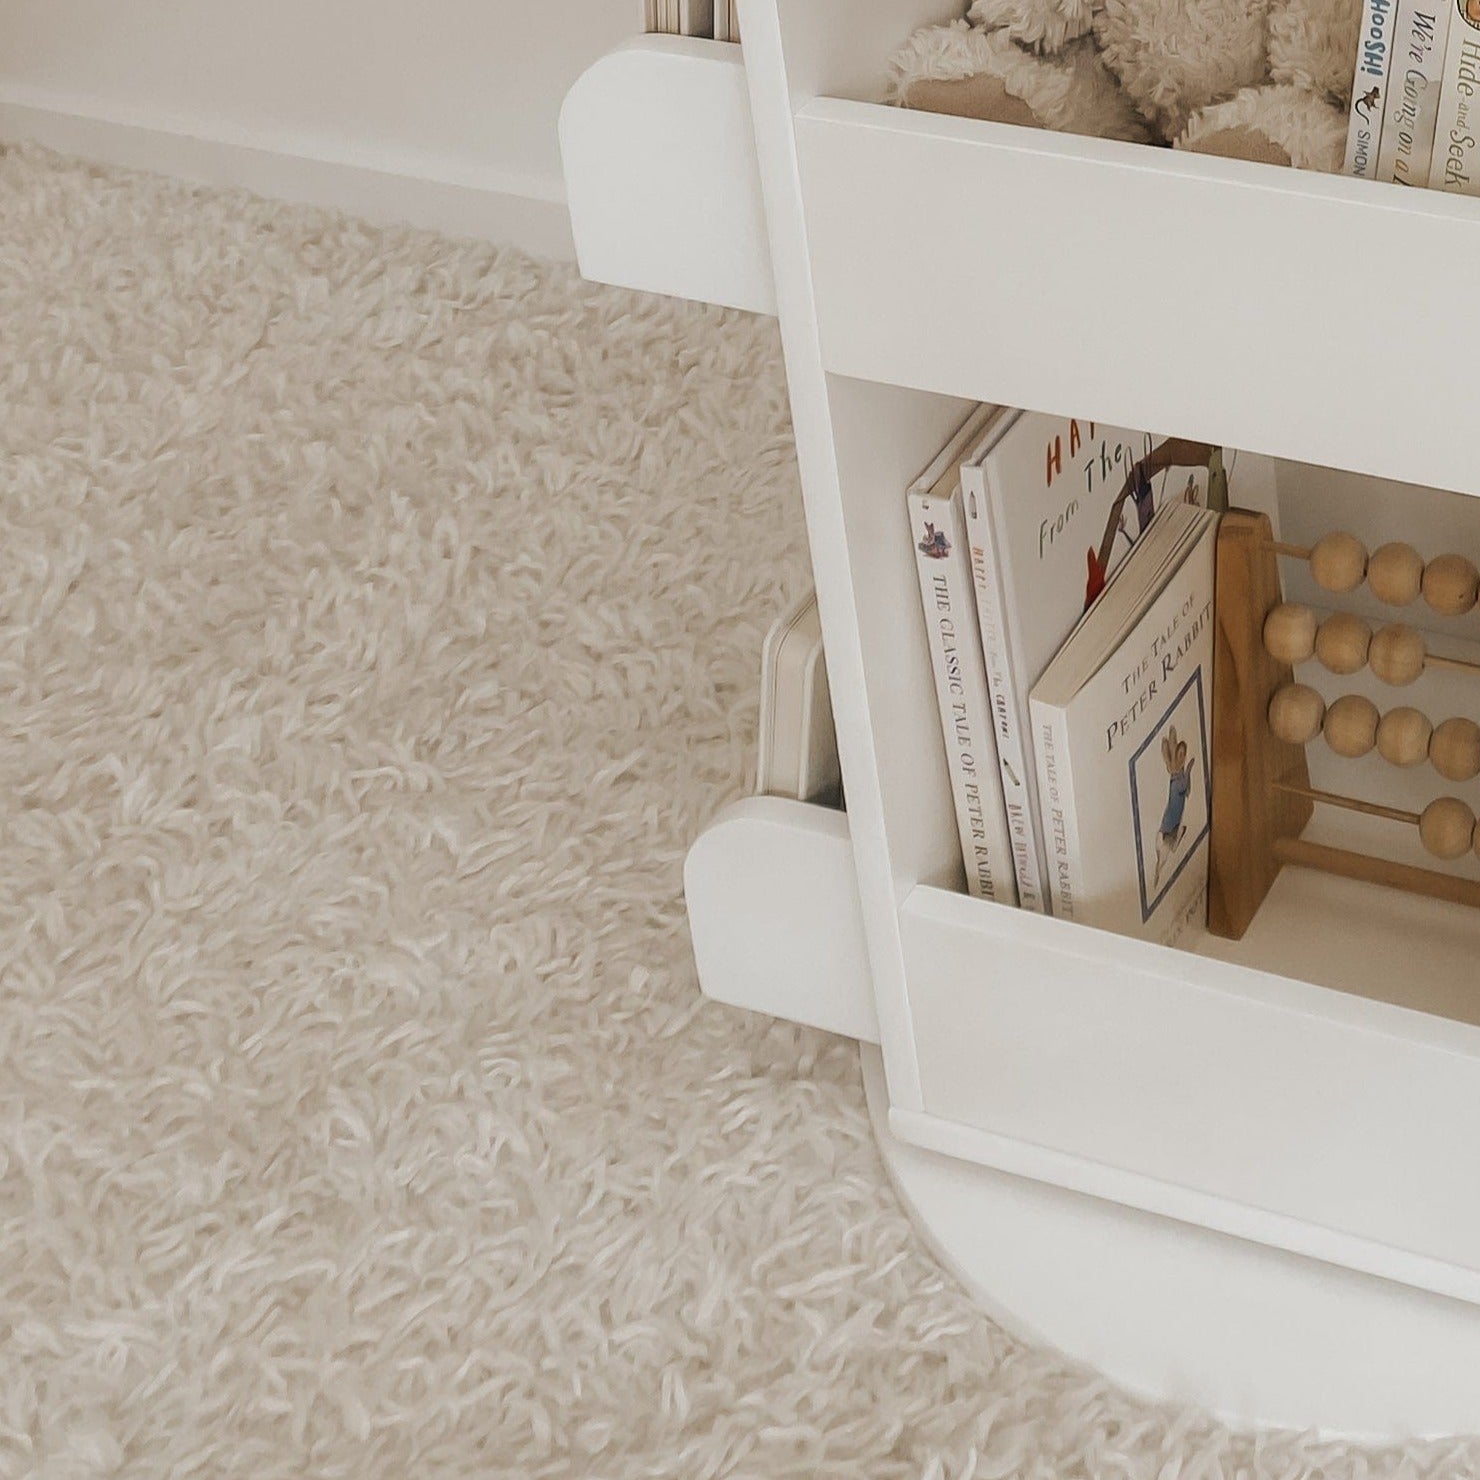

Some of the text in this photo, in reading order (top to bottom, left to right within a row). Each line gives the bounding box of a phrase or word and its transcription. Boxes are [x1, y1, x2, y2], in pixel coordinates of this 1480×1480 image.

[1409, 10, 1436, 63] We're
[1394, 69, 1429, 130] Going
[1353, 130, 1371, 176] SIMON
[1394, 159, 1409, 173] a
[1398, 131, 1413, 156] on
[1039, 499, 1080, 559] From
[1121, 594, 1195, 695] THE TALE OF
[1106, 600, 1212, 753] PETER RABBIT
[932, 575, 985, 840] THE CLASSIC TALE OF PETER
[1052, 808, 1068, 856] PETER
[1057, 860, 1074, 916] RABBIT
